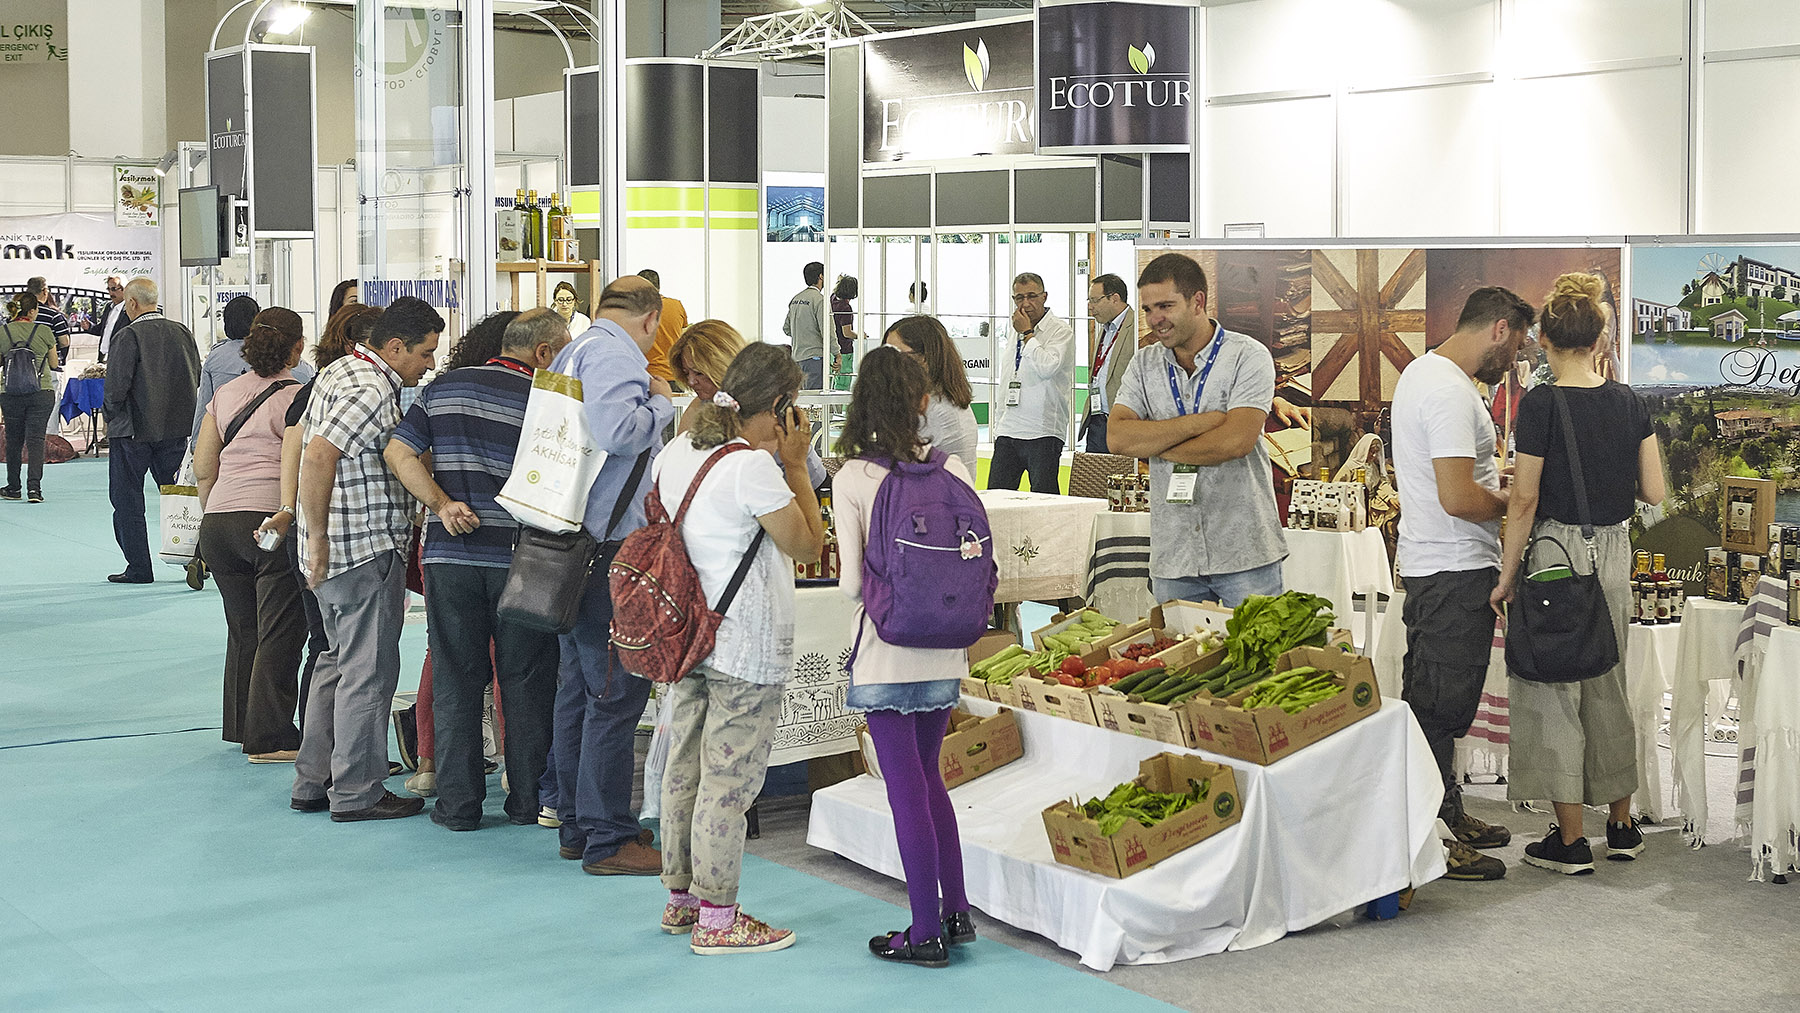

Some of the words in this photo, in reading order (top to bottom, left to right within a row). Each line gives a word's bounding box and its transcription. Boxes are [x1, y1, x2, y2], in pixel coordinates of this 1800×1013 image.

[13, 24, 53, 40] ÇIKIŞ
[5, 53, 23, 61] EXIT
[1049, 76, 1190, 111] ECOTUR
[495, 196, 513, 208] MSUN
[0, 239, 75, 260] mak
